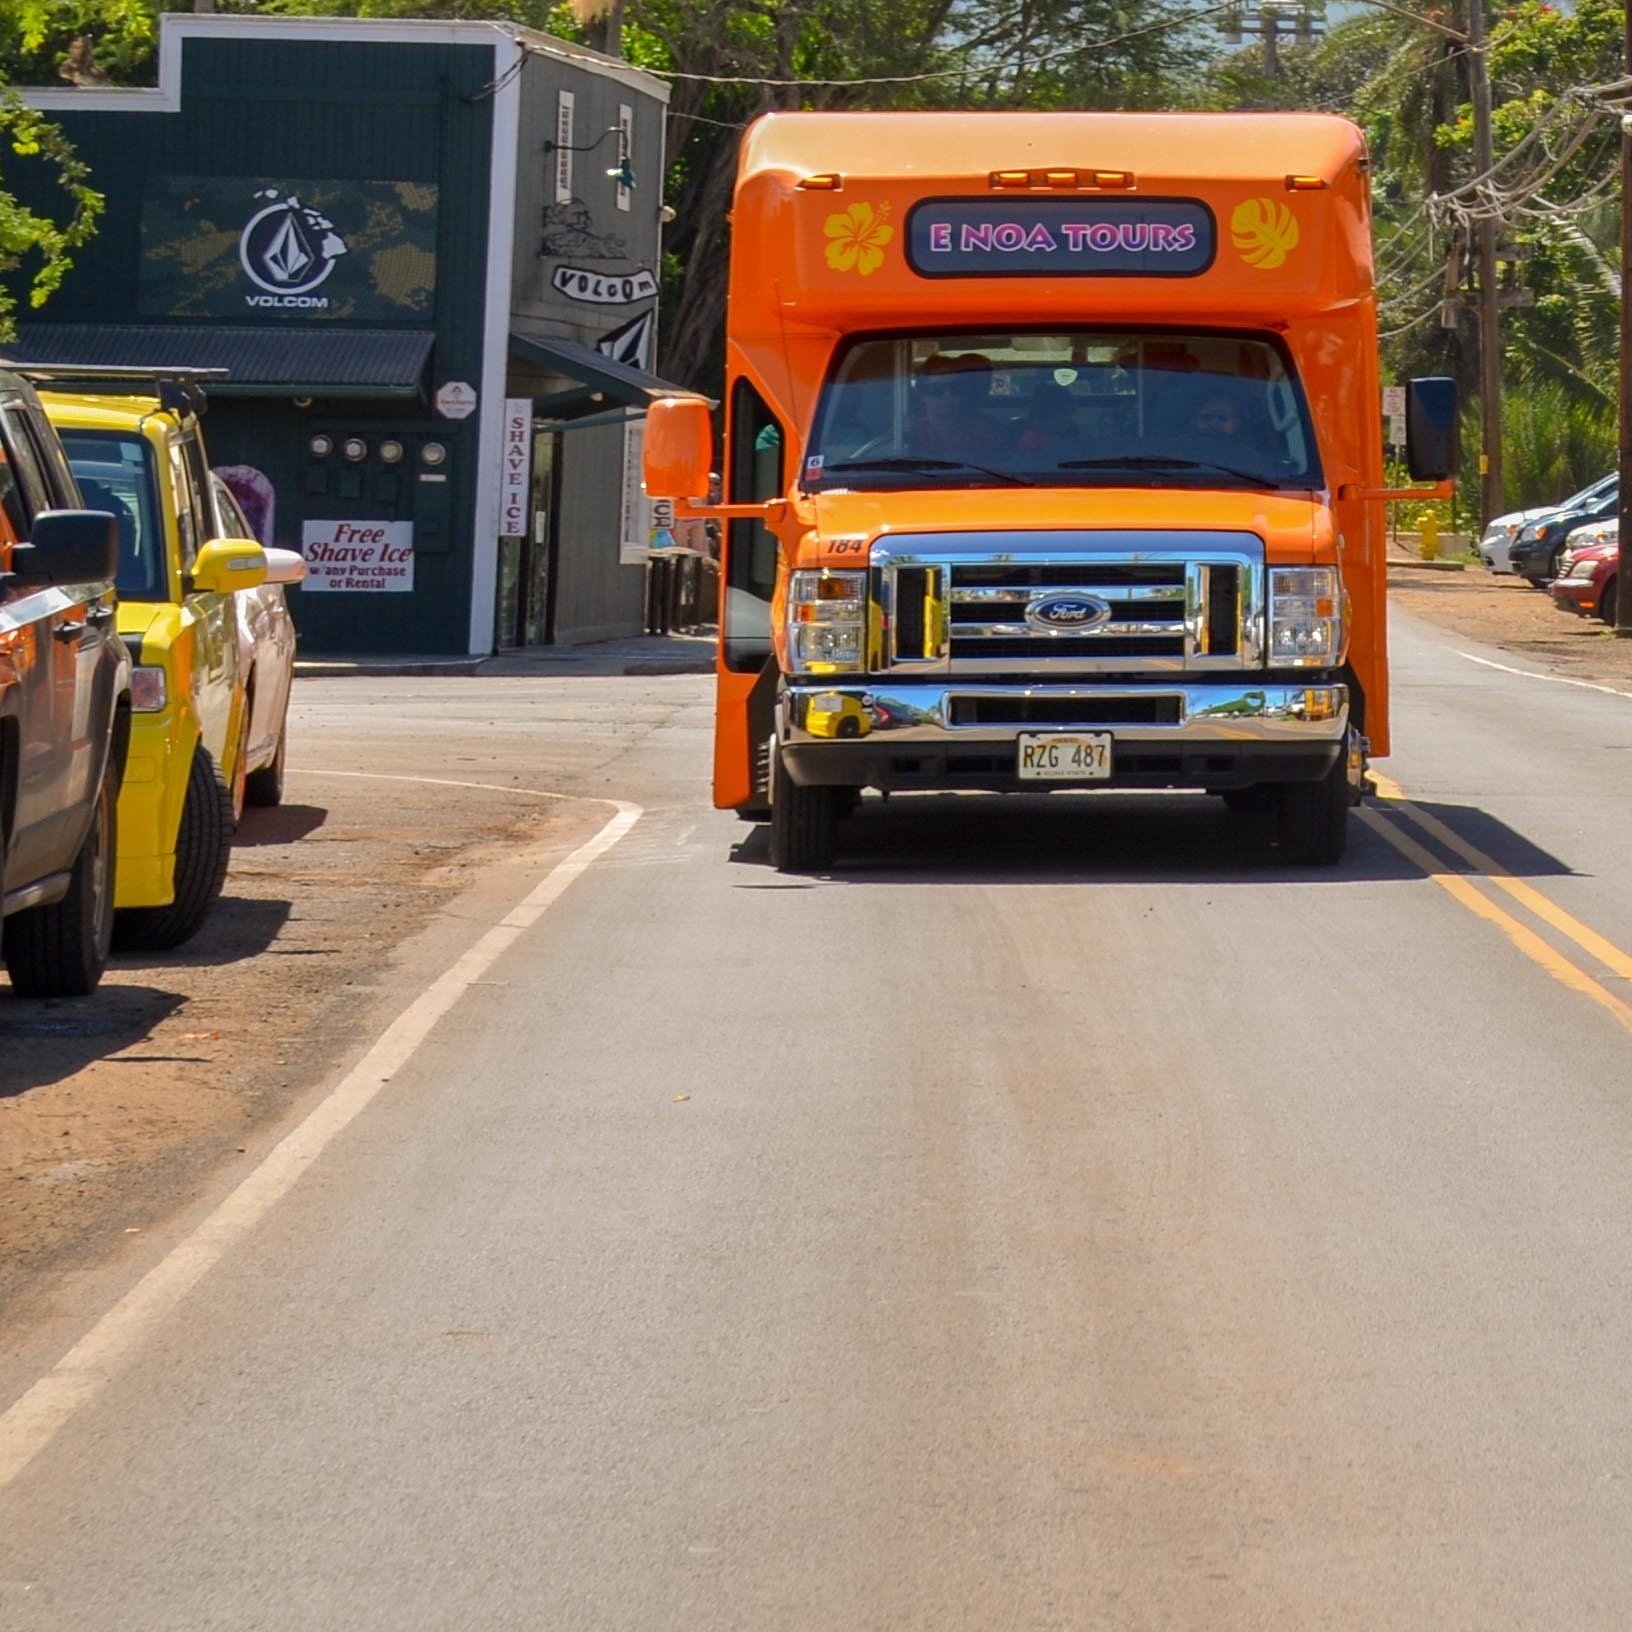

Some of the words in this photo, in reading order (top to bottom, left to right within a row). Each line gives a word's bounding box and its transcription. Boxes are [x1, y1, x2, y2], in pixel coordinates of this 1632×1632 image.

[930, 223, 951, 251] E
[960, 223, 1057, 251] NOA
[1061, 223, 1196, 251] TOURS
[245, 295, 329, 308] VOLCOM
[507, 417, 525, 486] SHAVE
[505, 492, 522, 534] ICE
[653, 499, 671, 528] CE
[333, 523, 385, 544] Free
[304, 542, 375, 563] Shave
[379, 543, 412, 563] Ice
[826, 539, 864, 554] 184
[325, 567, 346, 578] any
[349, 564, 407, 577] Purchase
[329, 579, 342, 589] or
[345, 577, 386, 589] Rental
[1049, 603, 1088, 620] Ford
[1024, 744, 1059, 769] RZG
[1071, 743, 1107, 768] 487
